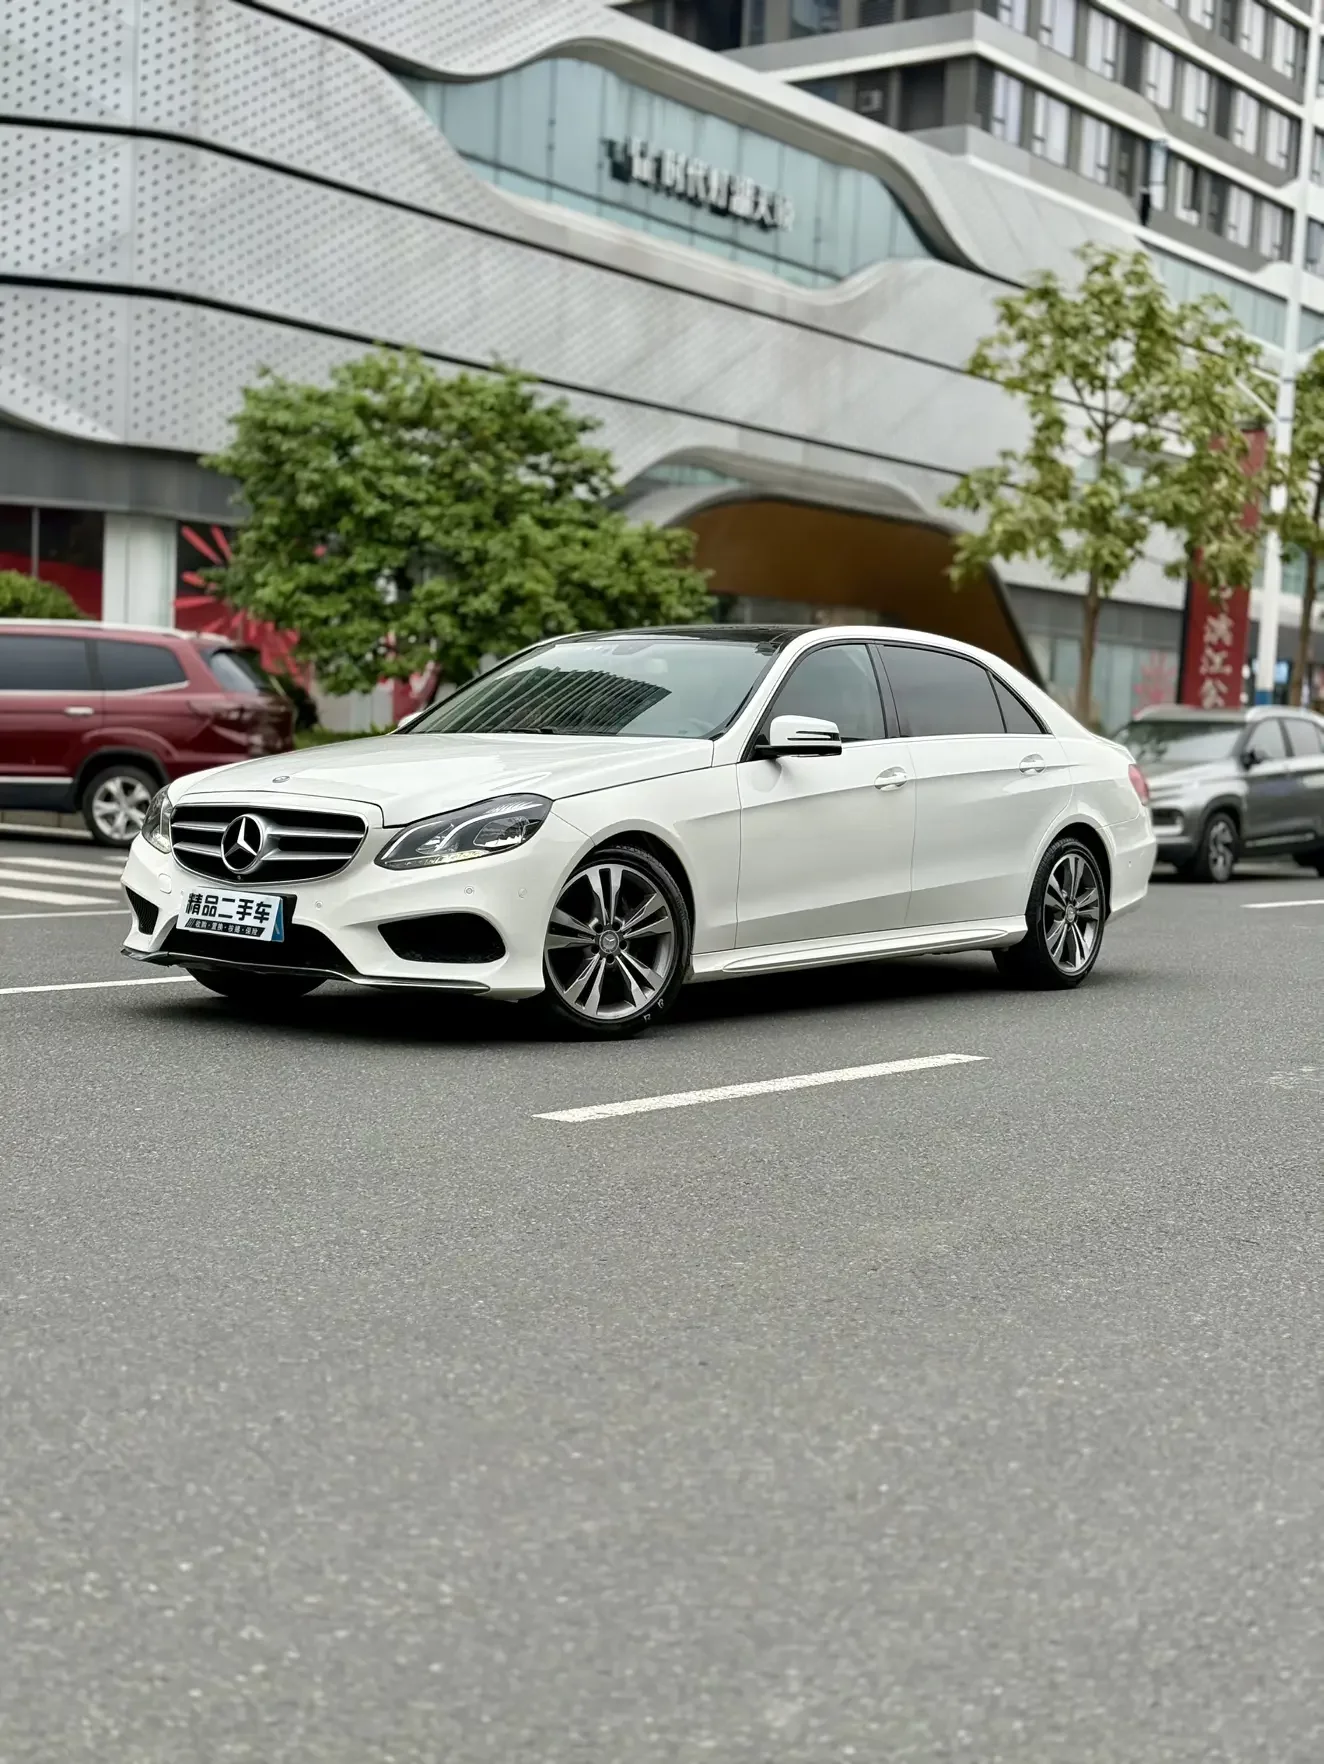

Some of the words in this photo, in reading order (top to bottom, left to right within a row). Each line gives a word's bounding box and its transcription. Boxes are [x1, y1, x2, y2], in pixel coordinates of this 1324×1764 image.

[185, 892, 272, 924] 精品二手车
